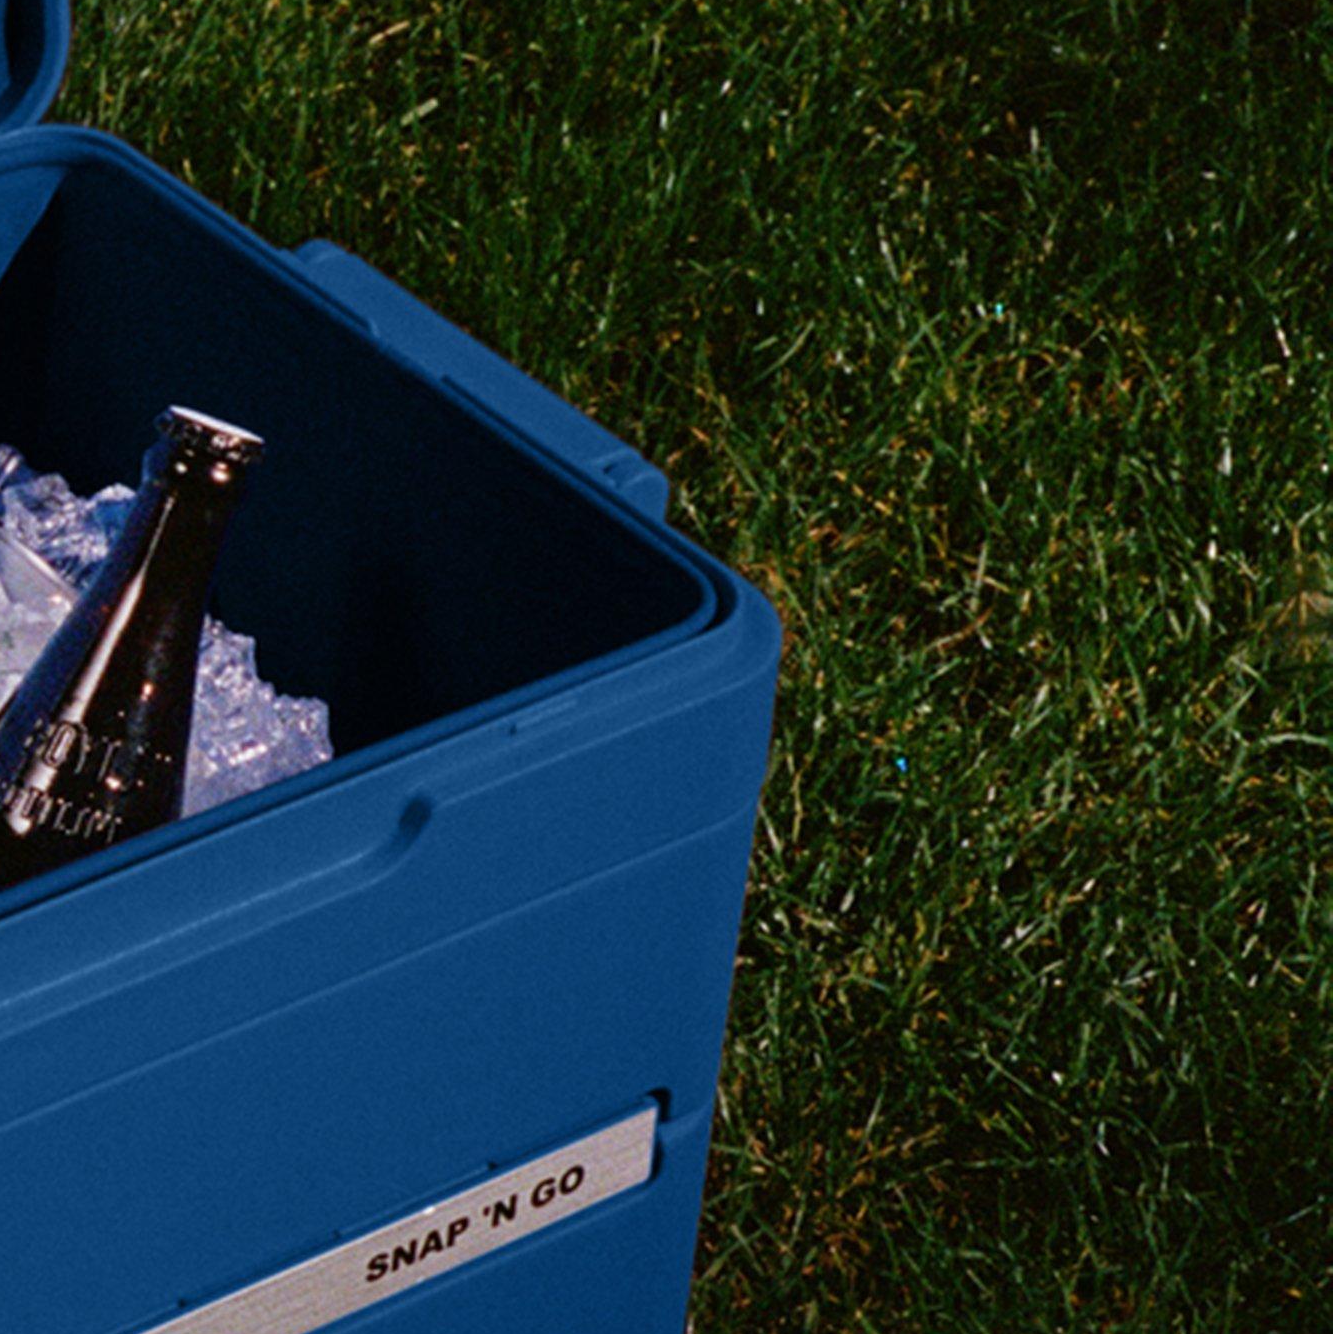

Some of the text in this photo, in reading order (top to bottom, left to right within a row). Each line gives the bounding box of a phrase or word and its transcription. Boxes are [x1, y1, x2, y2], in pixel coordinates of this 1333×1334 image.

[366, 1165, 585, 1283] SNAP 'N GO
